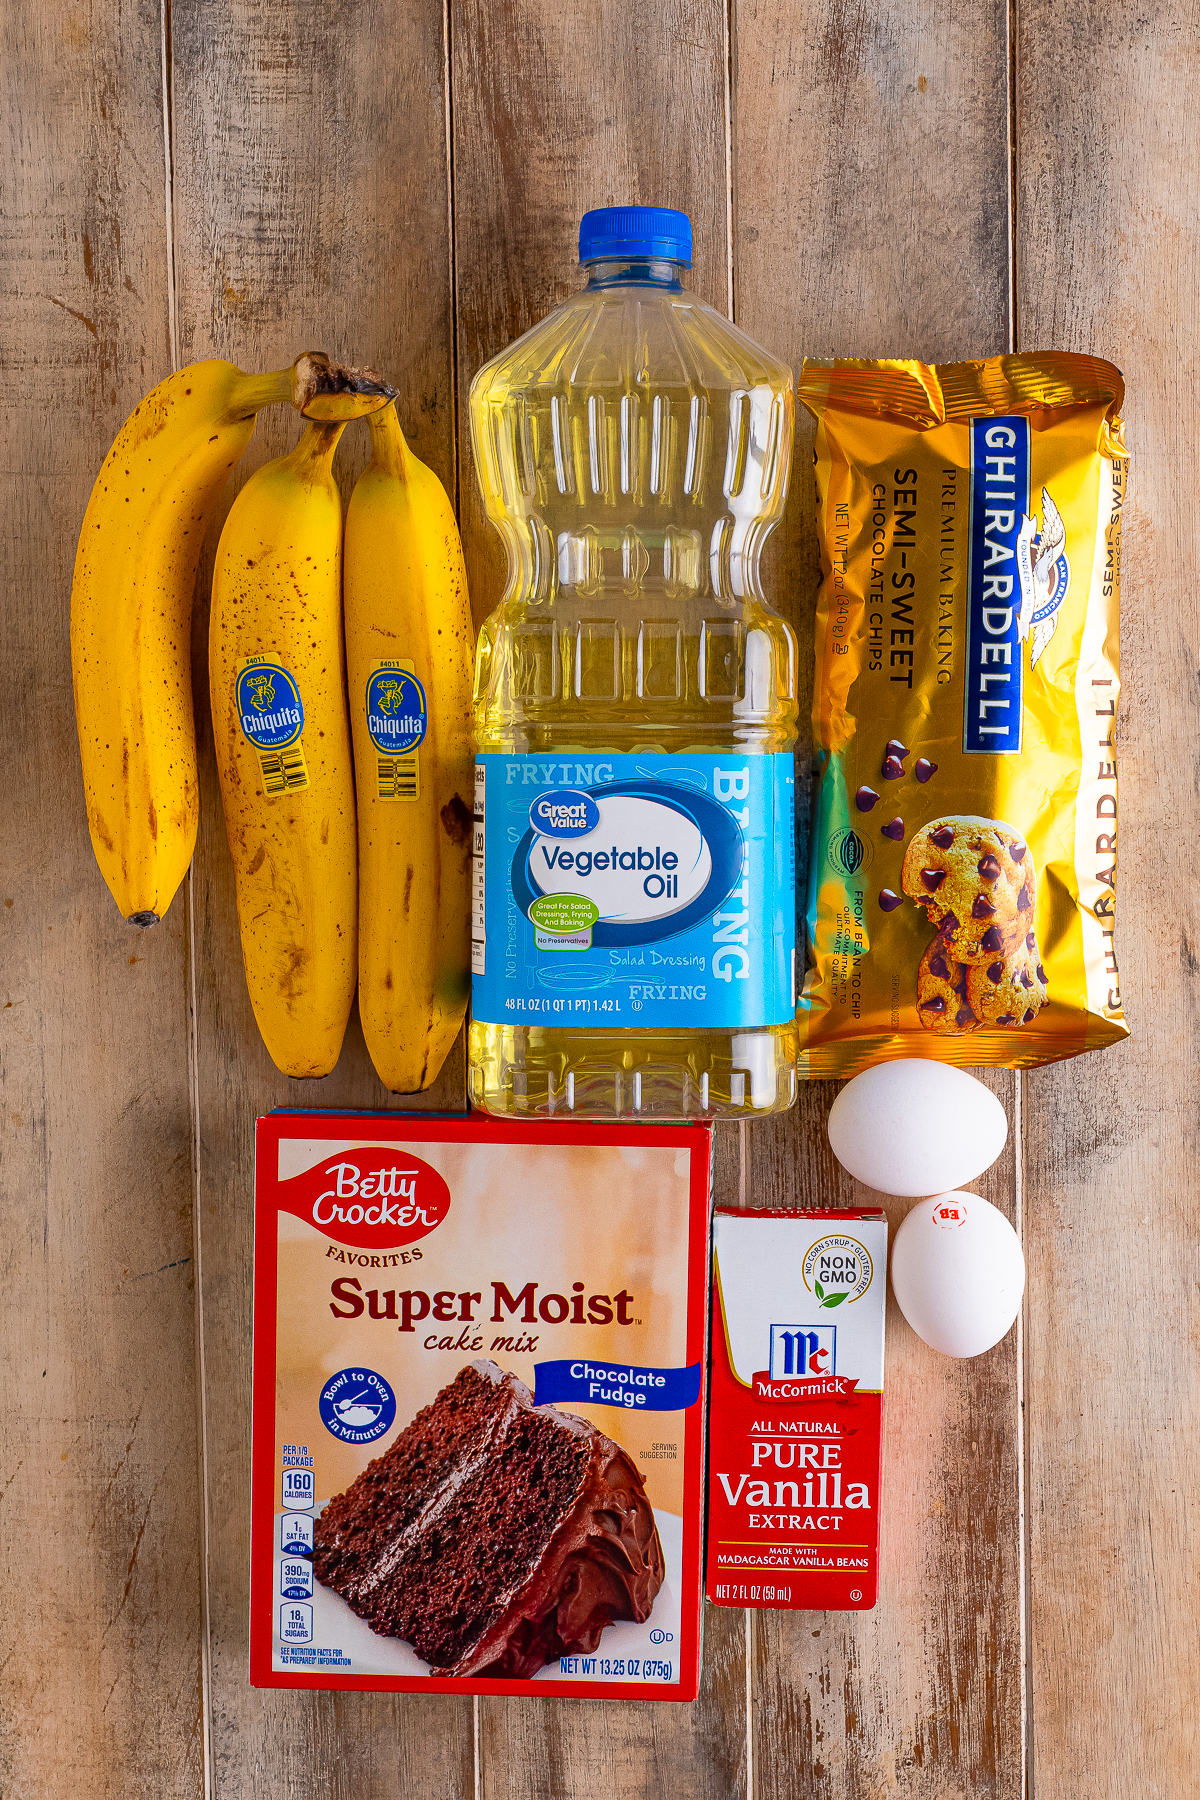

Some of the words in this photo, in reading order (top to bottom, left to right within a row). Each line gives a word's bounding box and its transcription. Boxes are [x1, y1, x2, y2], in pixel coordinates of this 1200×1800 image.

[835, 503, 850, 529] NET
[939, 469, 957, 587] PREMIUM
[834, 533, 849, 555] WT
[869, 483, 887, 604] CHOCOLATE
[1020, 539, 1031, 583] FOUNDED
[1058, 560, 1067, 579] SAN
[833, 559, 848, 590] 12oz
[890, 468, 918, 688] SEMI-SWEET
[979, 426, 1016, 735] GHIRARDELLI
[1033, 581, 1066, 620] FRANCISCO
[832, 594, 850, 638] (340g)
[868, 616, 883, 671] CHIPS
[936, 593, 955, 685] BAKING
[246, 655, 265, 665] #4011
[242, 706, 301, 734] Chiquita
[368, 714, 424, 738] Chiquita
[257, 729, 294, 744] Guatemala
[378, 738, 412, 748] Guatemala
[505, 763, 615, 785] FRYING
[538, 801, 587, 818] Great
[549, 816, 587, 829] Value
[542, 846, 679, 877] Vegetable
[712, 766, 750, 983] BING
[643, 874, 679, 899] Oil
[536, 910, 571, 919] Dressings,
[571, 911, 593, 920] Frying
[537, 902, 558, 910] Great
[558, 902, 570, 910] For
[570, 902, 591, 910] Salad
[843, 905, 851, 925] OUR
[853, 890, 864, 928] FROM
[559, 919, 585, 927] Baking
[547, 937, 589, 945] Preservatives
[833, 912, 843, 956] ULTIMATE
[840, 928, 851, 987] COMMITMENT
[852, 932, 863, 967] BEAN
[505, 961, 517, 979] No
[609, 950, 646, 966] Salad
[649, 949, 706, 971] Dressing
[831, 958, 840, 997] QUALITY
[851, 972, 862, 988] TO
[628, 985, 707, 1000] FRYING
[839, 988, 847, 1005] TO
[505, 998, 516, 1010] 48
[516, 998, 527, 1011] FL
[528, 998, 540, 1011] OZ
[541, 998, 551, 1013] (1
[552, 999, 567, 1012] QT
[567, 999, 573, 1011] 1
[574, 999, 591, 1013] PT)
[592, 999, 614, 1012] 1.42
[615, 1000, 622, 1012] L
[851, 992, 862, 1020] CHIP
[325, 1162, 420, 1206] Betty
[312, 1190, 438, 1228] Crocker
[939, 1207, 960, 1220] EB
[824, 1238, 850, 1248] SYRUP
[325, 1245, 424, 1268] FAVORITES
[808, 1245, 826, 1263] CORN
[819, 1255, 857, 1270] NON
[854, 1247, 870, 1276] GLUTEN
[805, 1262, 813, 1275] NO
[818, 1270, 858, 1284] GMO
[854, 1276, 869, 1295] FREE
[329, 1276, 482, 1332] Super
[490, 1281, 635, 1326] Moist
[423, 1328, 484, 1351] cake
[490, 1333, 538, 1353] mix
[569, 1362, 667, 1388] Chocolate
[323, 1373, 349, 1402] Bowl
[351, 1372, 365, 1382] to
[367, 1375, 390, 1403] Oven
[588, 1382, 647, 1407] Fudge
[756, 1379, 845, 1400] McCormick
[327, 1418, 340, 1433] in
[339, 1421, 387, 1441] Minutes
[750, 1420, 776, 1434] ALL
[778, 1421, 841, 1435] NATURAL
[282, 1444, 297, 1455] PER
[298, 1446, 309, 1456] 1/9
[639, 1451, 678, 1460] SUGGESTION
[651, 1443, 678, 1452] SERVING
[751, 1442, 842, 1470] PURE
[282, 1455, 315, 1467] PACKAGE
[286, 1473, 311, 1490] 160
[716, 1472, 872, 1510] Vanilla
[284, 1490, 313, 1499] CALORIES
[748, 1514, 844, 1531] EXTRACT
[286, 1532, 297, 1540] SAT
[298, 1533, 310, 1541] FAT
[717, 1555, 790, 1566] MADAGASCAR
[792, 1556, 835, 1567] VANILLA
[836, 1558, 869, 1568] BEANS
[768, 1547, 793, 1555] MADE
[795, 1548, 818, 1556] WITH
[285, 1577, 309, 1586] SODIUM
[715, 1584, 731, 1599] NET
[732, 1584, 738, 1599] 2
[739, 1585, 748, 1600] FL
[750, 1585, 761, 1600] OZ
[762, 1586, 775, 1602] (59
[777, 1586, 792, 1602] mL)
[284, 1629, 309, 1638] SUGARS
[288, 1621, 306, 1630] TOTAL
[280, 1646, 290, 1656] SEE
[290, 1647, 317, 1657] NUTRITION
[316, 1648, 332, 1657] FACTS
[332, 1649, 343, 1658] FOR
[317, 1657, 352, 1666] INFORMATION
[560, 1656, 580, 1674] NET
[581, 1658, 598, 1675] WT
[599, 1659, 625, 1675] 13.25
[627, 1660, 640, 1676] OZ
[642, 1660, 673, 1680] (375g)
